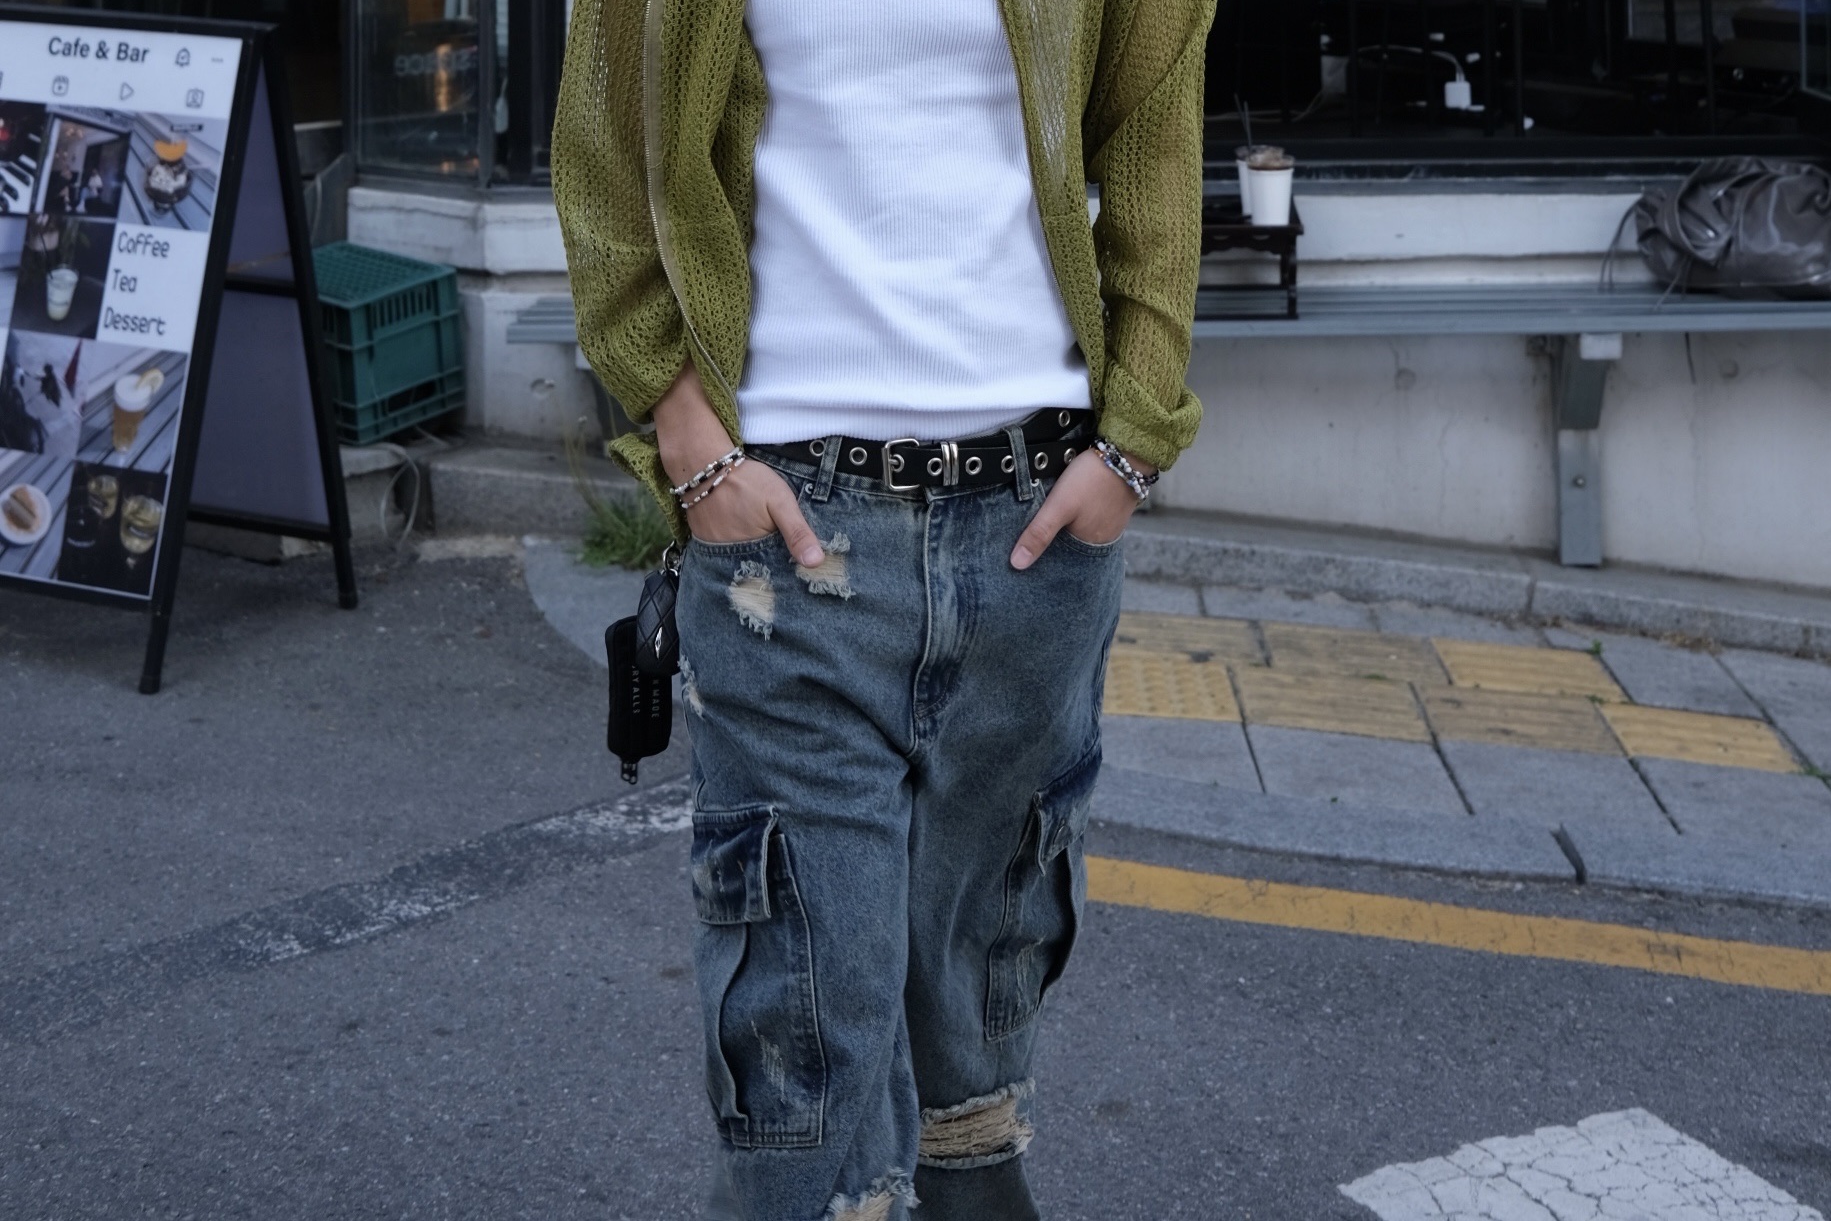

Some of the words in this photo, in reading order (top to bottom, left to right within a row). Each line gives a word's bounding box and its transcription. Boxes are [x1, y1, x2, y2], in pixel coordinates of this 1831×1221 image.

[48, 36, 90, 59] Cafe
[95, 40, 110, 60] &
[116, 42, 150, 64] Bar
[117, 231, 170, 259] Coffee
[112, 269, 137, 293] Tea
[104, 307, 166, 336] Dessert
